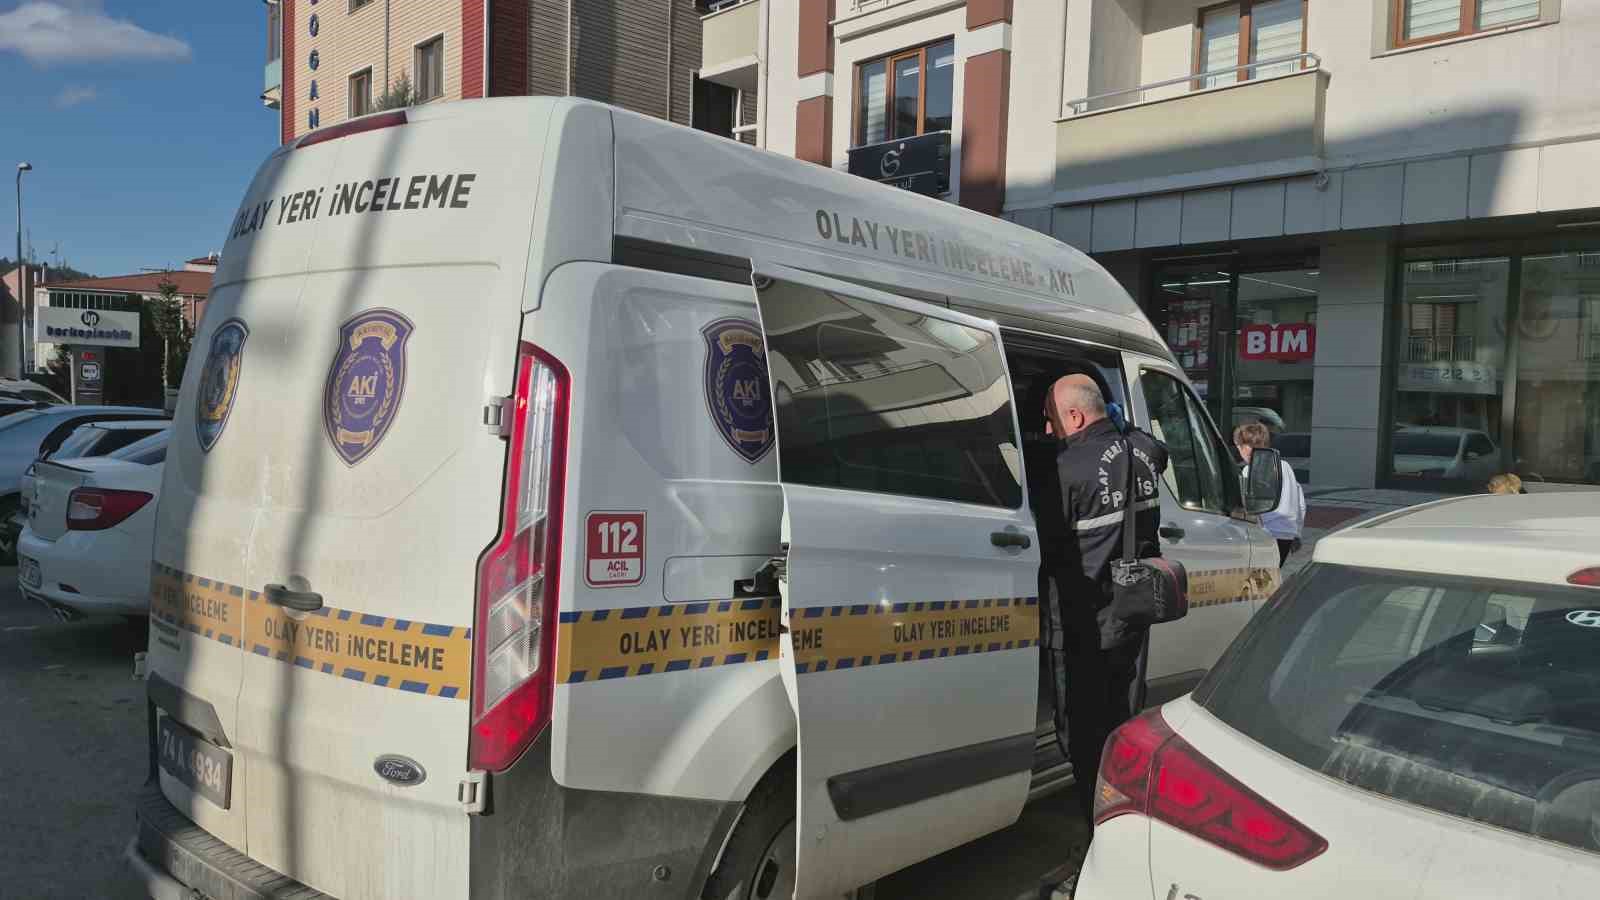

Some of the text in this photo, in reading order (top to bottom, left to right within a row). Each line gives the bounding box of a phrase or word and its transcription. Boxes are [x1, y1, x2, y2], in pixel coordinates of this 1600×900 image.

[815, 209, 879, 250] OLAY
[1099, 467, 1110, 505] OLAY
[598, 521, 638, 554] 112
[264, 618, 299, 644] OLAY
[619, 629, 671, 655] OLAY
[894, 625, 926, 643] OLAY
